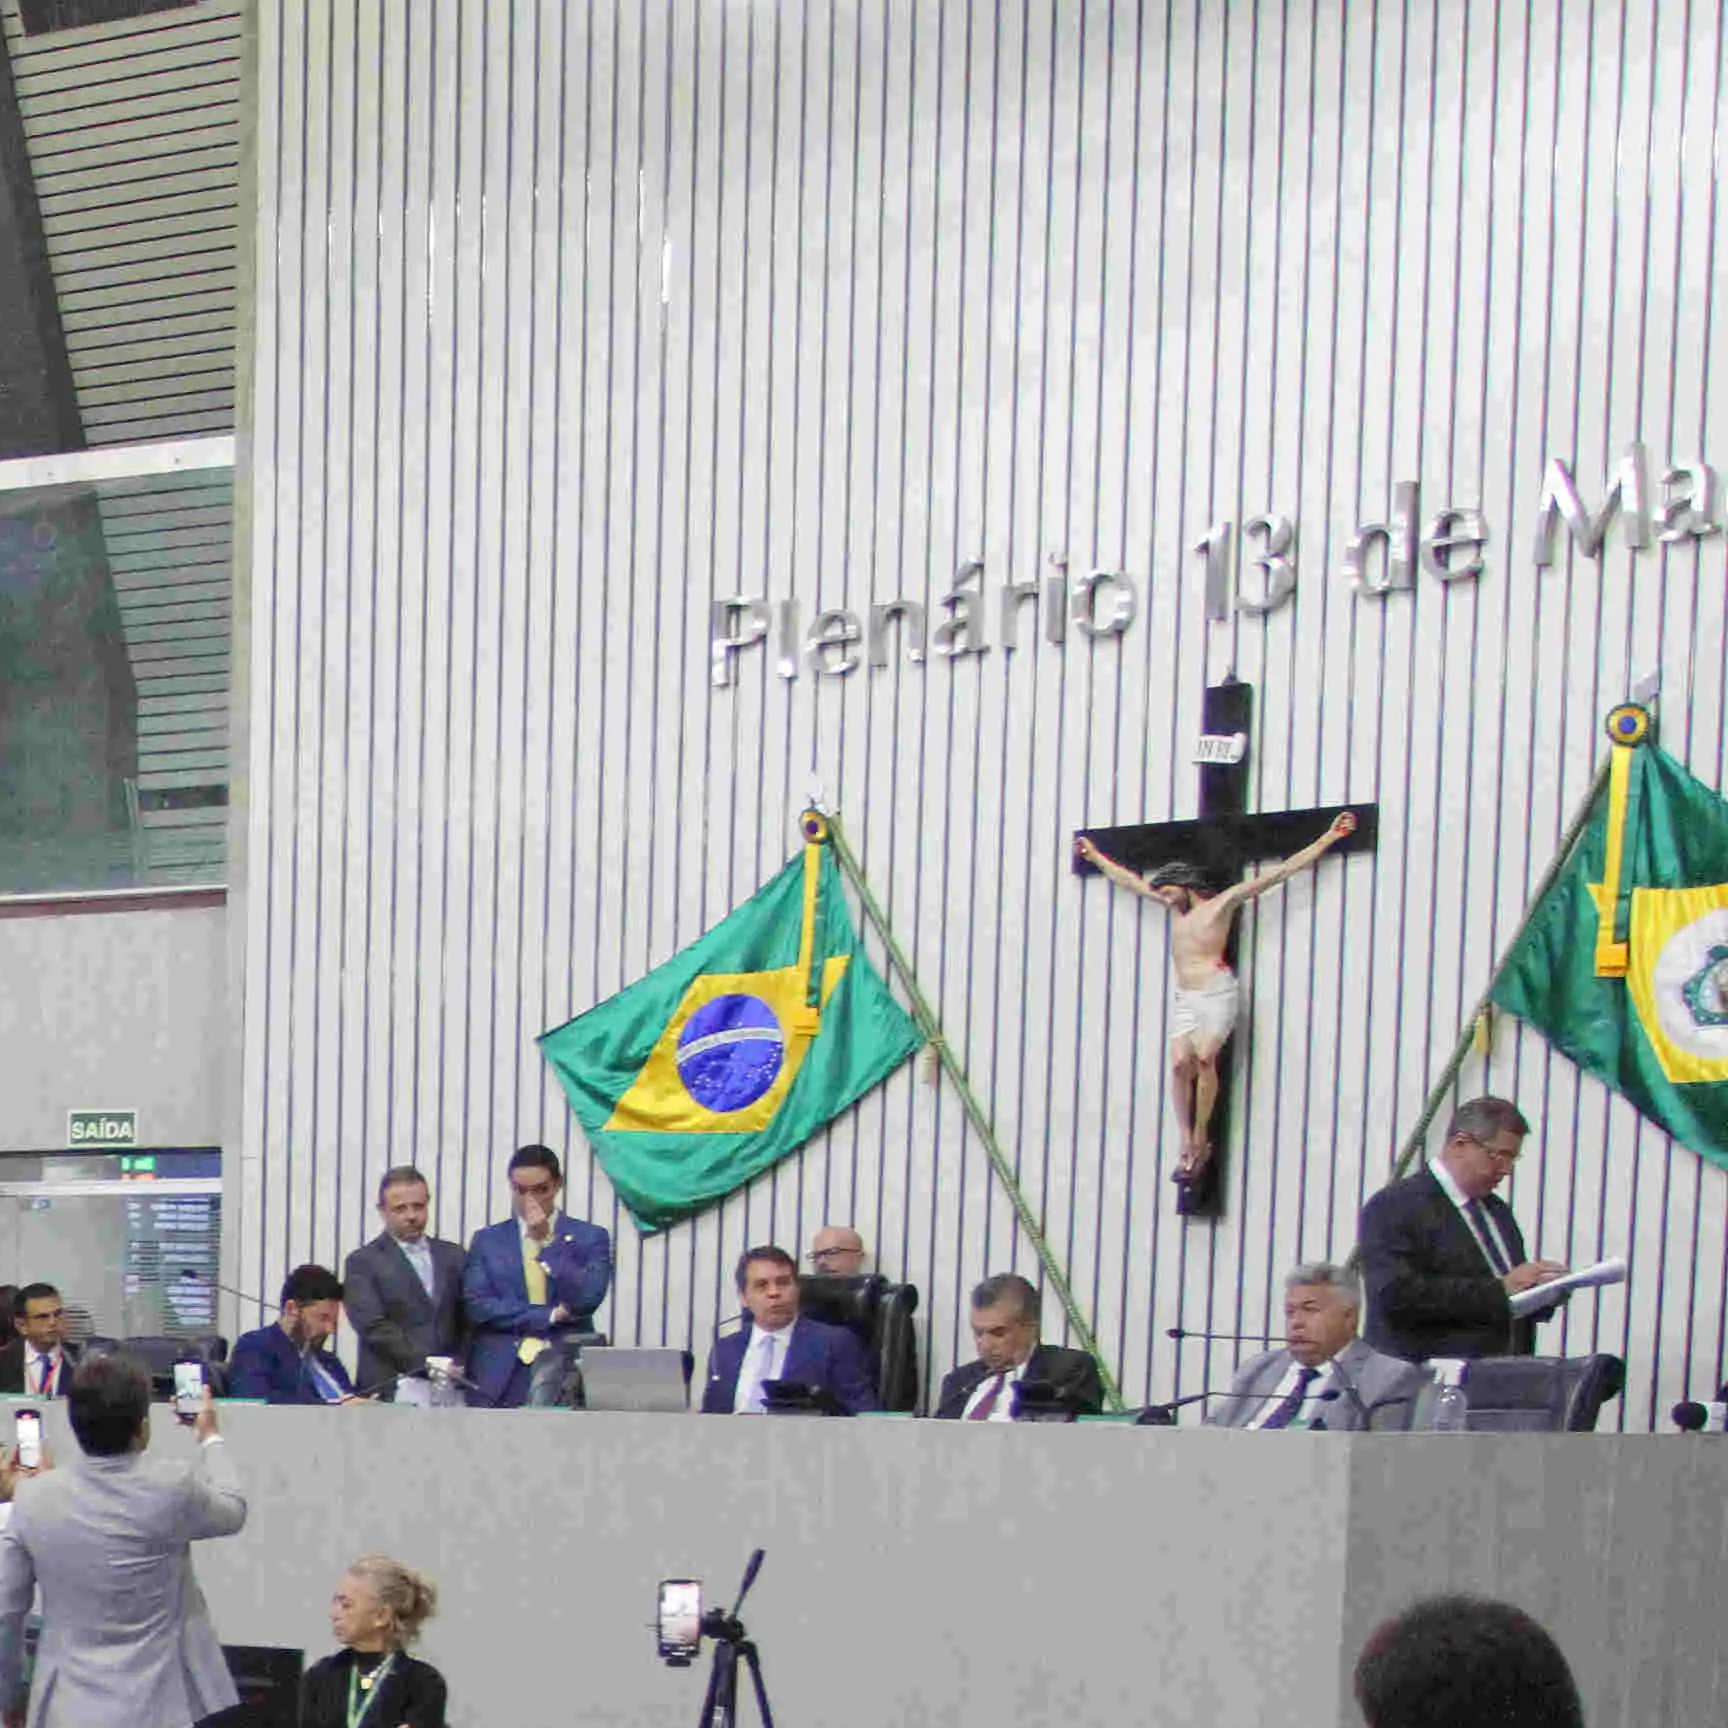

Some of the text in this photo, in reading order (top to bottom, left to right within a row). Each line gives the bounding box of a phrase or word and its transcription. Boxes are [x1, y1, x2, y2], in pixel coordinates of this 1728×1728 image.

[709, 441, 1728, 687] Plenário 13 de Ma
[70, 1117, 133, 1139] SAÍDA
